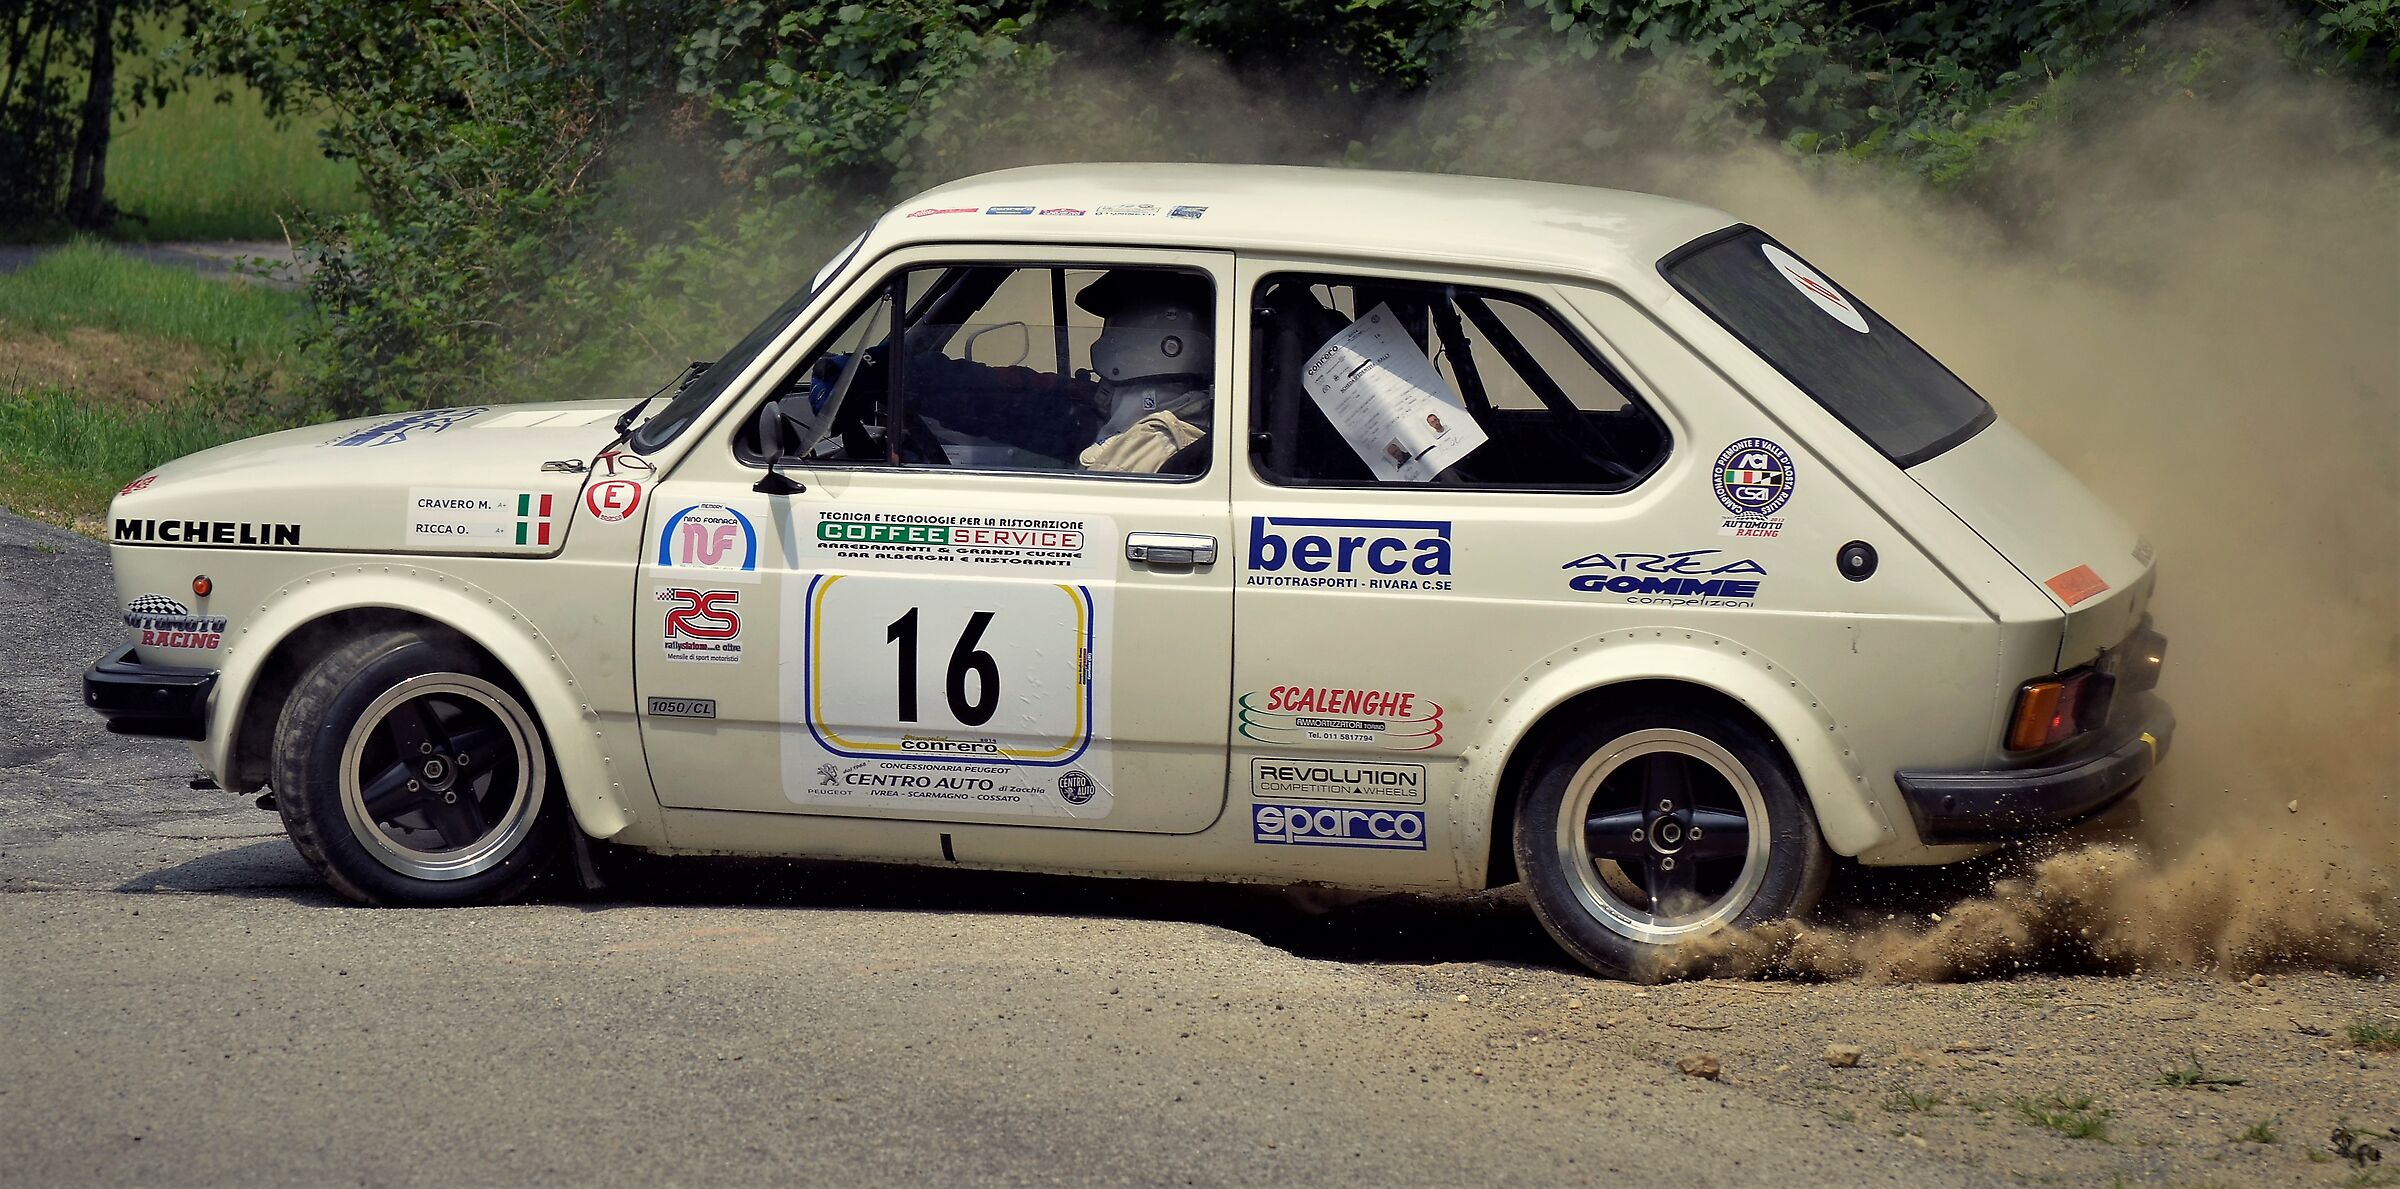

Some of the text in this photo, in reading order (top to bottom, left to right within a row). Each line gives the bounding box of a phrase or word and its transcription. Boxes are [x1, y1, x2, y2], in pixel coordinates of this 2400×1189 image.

[1307, 345, 1339, 376] conrero
[1718, 440, 1753, 466] PIEMONTE
[1762, 441, 1783, 458] VALLE
[1780, 454, 1794, 490] D'AOSTA
[604, 485, 625, 508] E
[1714, 466, 1743, 513] CAMPIONATO
[418, 498, 474, 509] CRAVERO
[478, 500, 492, 510] M.
[1761, 491, 1789, 514] RALLIES
[416, 523, 453, 534] RICCA
[457, 524, 470, 535] O.
[703, 517, 738, 525] FORNACA
[820, 512, 870, 521] TECNICA
[884, 514, 956, 524] TECNOLOGIE
[960, 517, 981, 526] PER
[985, 518, 996, 527] LA
[1000, 519, 1084, 530] RISTORAZIONE
[1722, 520, 1783, 530] AUTOMOTO
[115, 518, 301, 546] MICHELIN
[825, 524, 1077, 548] COFFEE SERVICE
[1736, 529, 1780, 538] RACING
[817, 542, 931, 553] ARREDAMENTI
[956, 548, 1020, 556] GRANDI
[1248, 516, 1452, 576] berca
[875, 553, 954, 562] ALBERGHI
[974, 556, 1071, 567] RISTORANTI
[1561, 549, 1768, 576] AREA
[1247, 576, 1358, 588] AUTOTRASPORTI
[1370, 579, 1419, 590] RIVARA
[1423, 580, 1452, 591] C.SE
[1569, 574, 1761, 599] GOMME
[1626, 595, 1754, 609] competizioni
[665, 588, 741, 641] RS
[141, 630, 221, 650] RACING
[886, 606, 1000, 727] 16
[652, 701, 711, 714] 1050/CL
[1267, 686, 1415, 718] SCALENGHE
[1296, 718, 1363, 729] AMMORTIZZATORI
[1308, 731, 1322, 739] Tel.
[1340, 733, 1373, 742] 5817794
[901, 740, 997, 753] conrero
[880, 762, 1011, 775] CONCESSIONARIA PEUGEOT
[845, 773, 1046, 795] CENTRO AUTO di Zacchia
[1060, 777, 1086, 789] CENTRO
[1077, 784, 1095, 795] AUTO
[1260, 781, 1418, 797] COMPETITION WHEELS
[807, 788, 853, 796] PEUGEOT
[870, 789, 899, 797] IVREA
[907, 790, 969, 800] SCARMAGNO
[977, 793, 1021, 803] COSSATO
[1256, 806, 1423, 844] sparco
